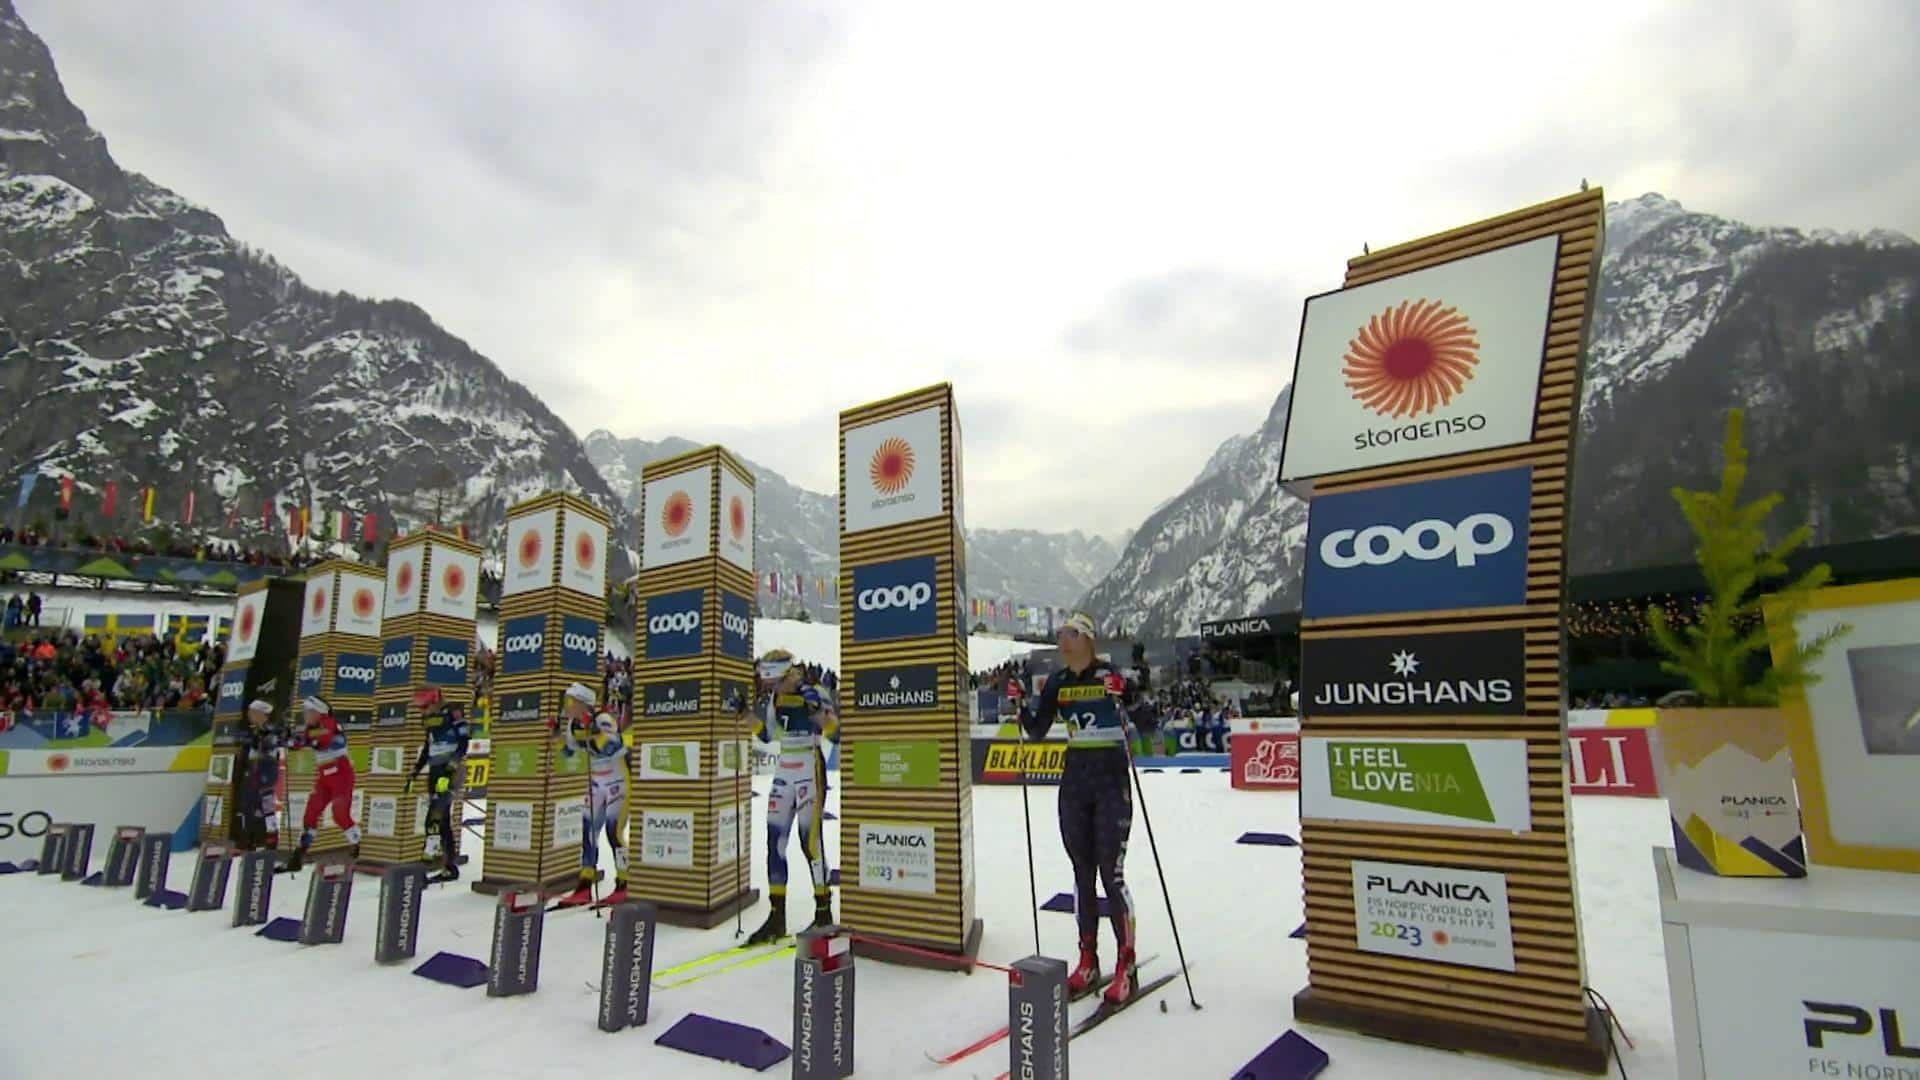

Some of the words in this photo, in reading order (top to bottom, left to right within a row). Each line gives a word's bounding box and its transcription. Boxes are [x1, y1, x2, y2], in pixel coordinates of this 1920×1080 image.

[1320, 512, 1514, 568] coop
[858, 581, 931, 611] coop
[649, 610, 700, 635] coop
[723, 611, 749, 640] coop
[1202, 618, 1272, 638] PLANICA
[506, 633, 543, 652] coop
[564, 632, 597, 656] coop
[383, 651, 411, 668] coop
[429, 651, 466, 671] coop
[338, 665, 375, 683] coop
[858, 689, 935, 707] JUNGHANS
[1315, 679, 1513, 705] JUNGHANS
[1333, 747, 1344, 766] I
[1350, 747, 1407, 768] FEEL
[865, 832, 927, 848] PLANICA
[1367, 875, 1491, 903] PLANICA
[1369, 921, 1423, 947] 2023
[800, 963, 814, 1073] JUNGHANS
